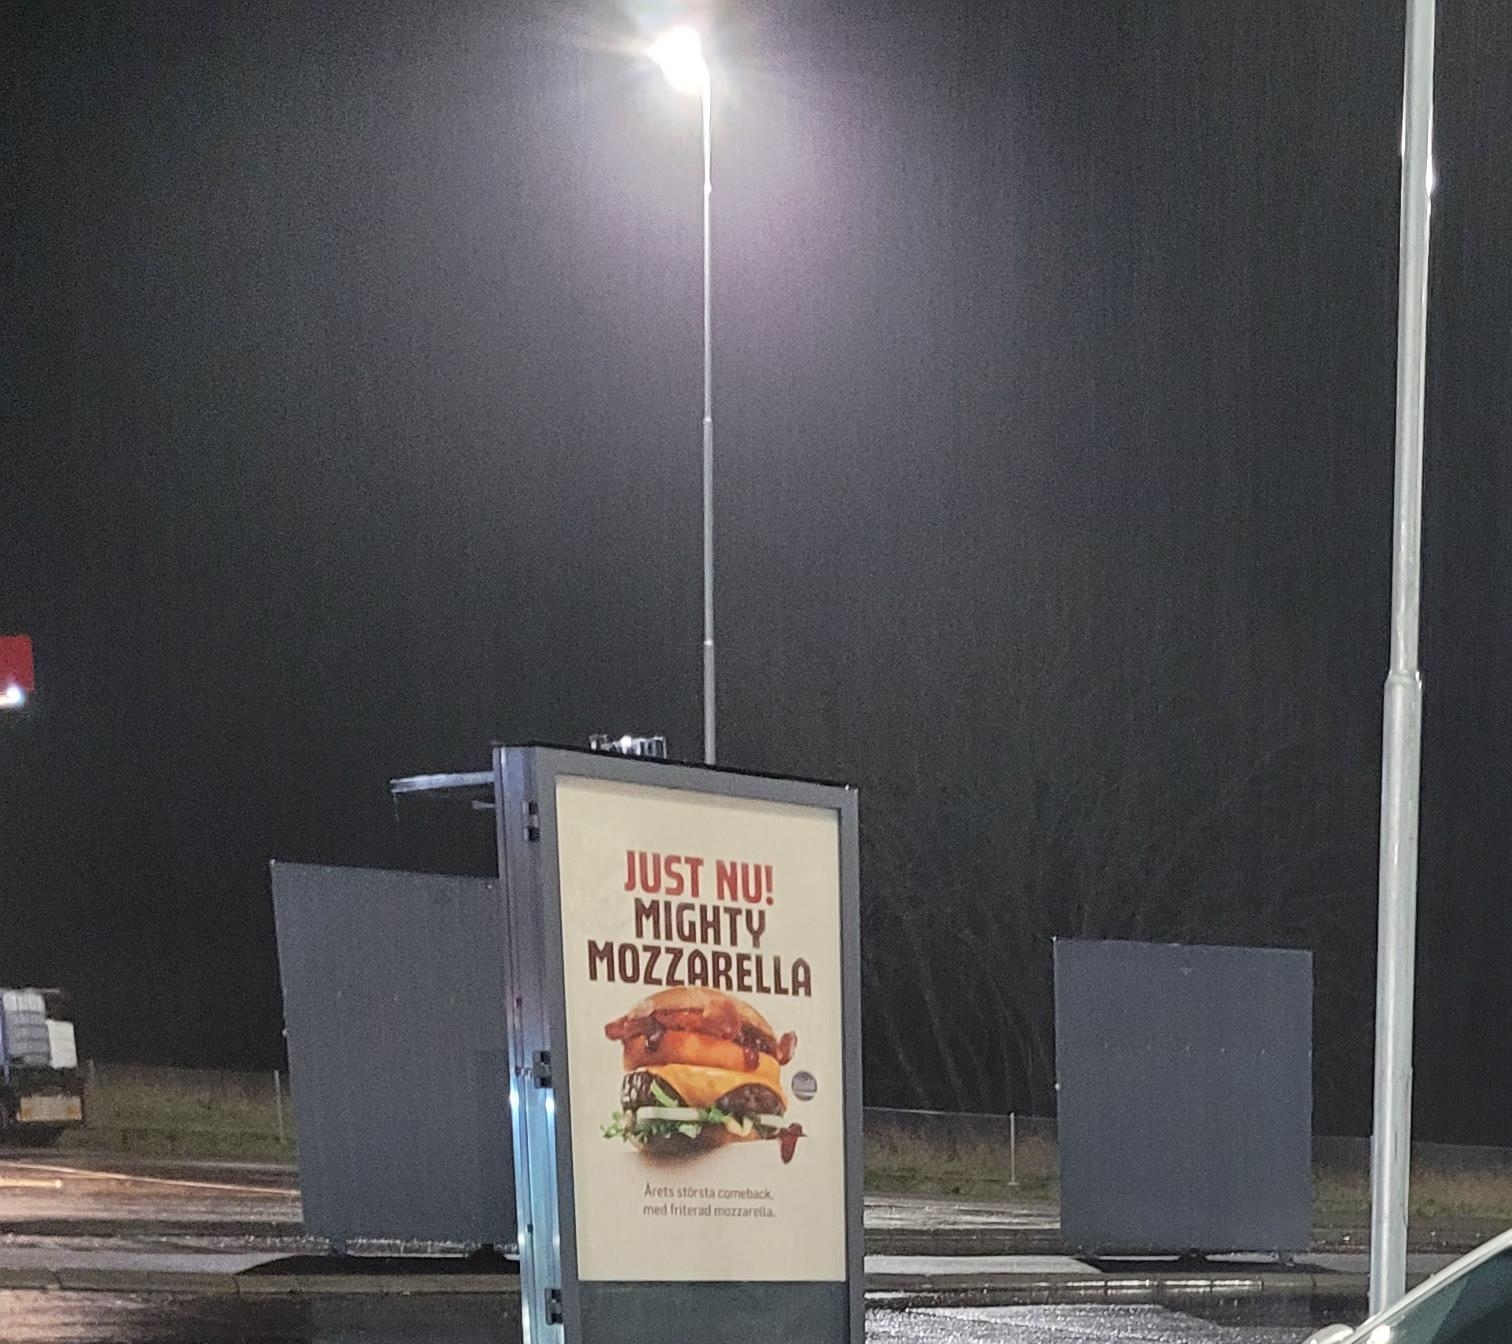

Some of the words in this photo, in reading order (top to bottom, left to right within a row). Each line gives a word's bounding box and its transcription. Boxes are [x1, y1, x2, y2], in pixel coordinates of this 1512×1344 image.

[624, 850, 704, 898] JUST
[716, 859, 774, 906] NU!
[634, 898, 766, 949] MIGHTY
[587, 939, 812, 997] MOZZARELLA
[643, 1204, 667, 1216] med
[670, 1203, 711, 1217] friterad
[644, 1180, 674, 1198] Årets
